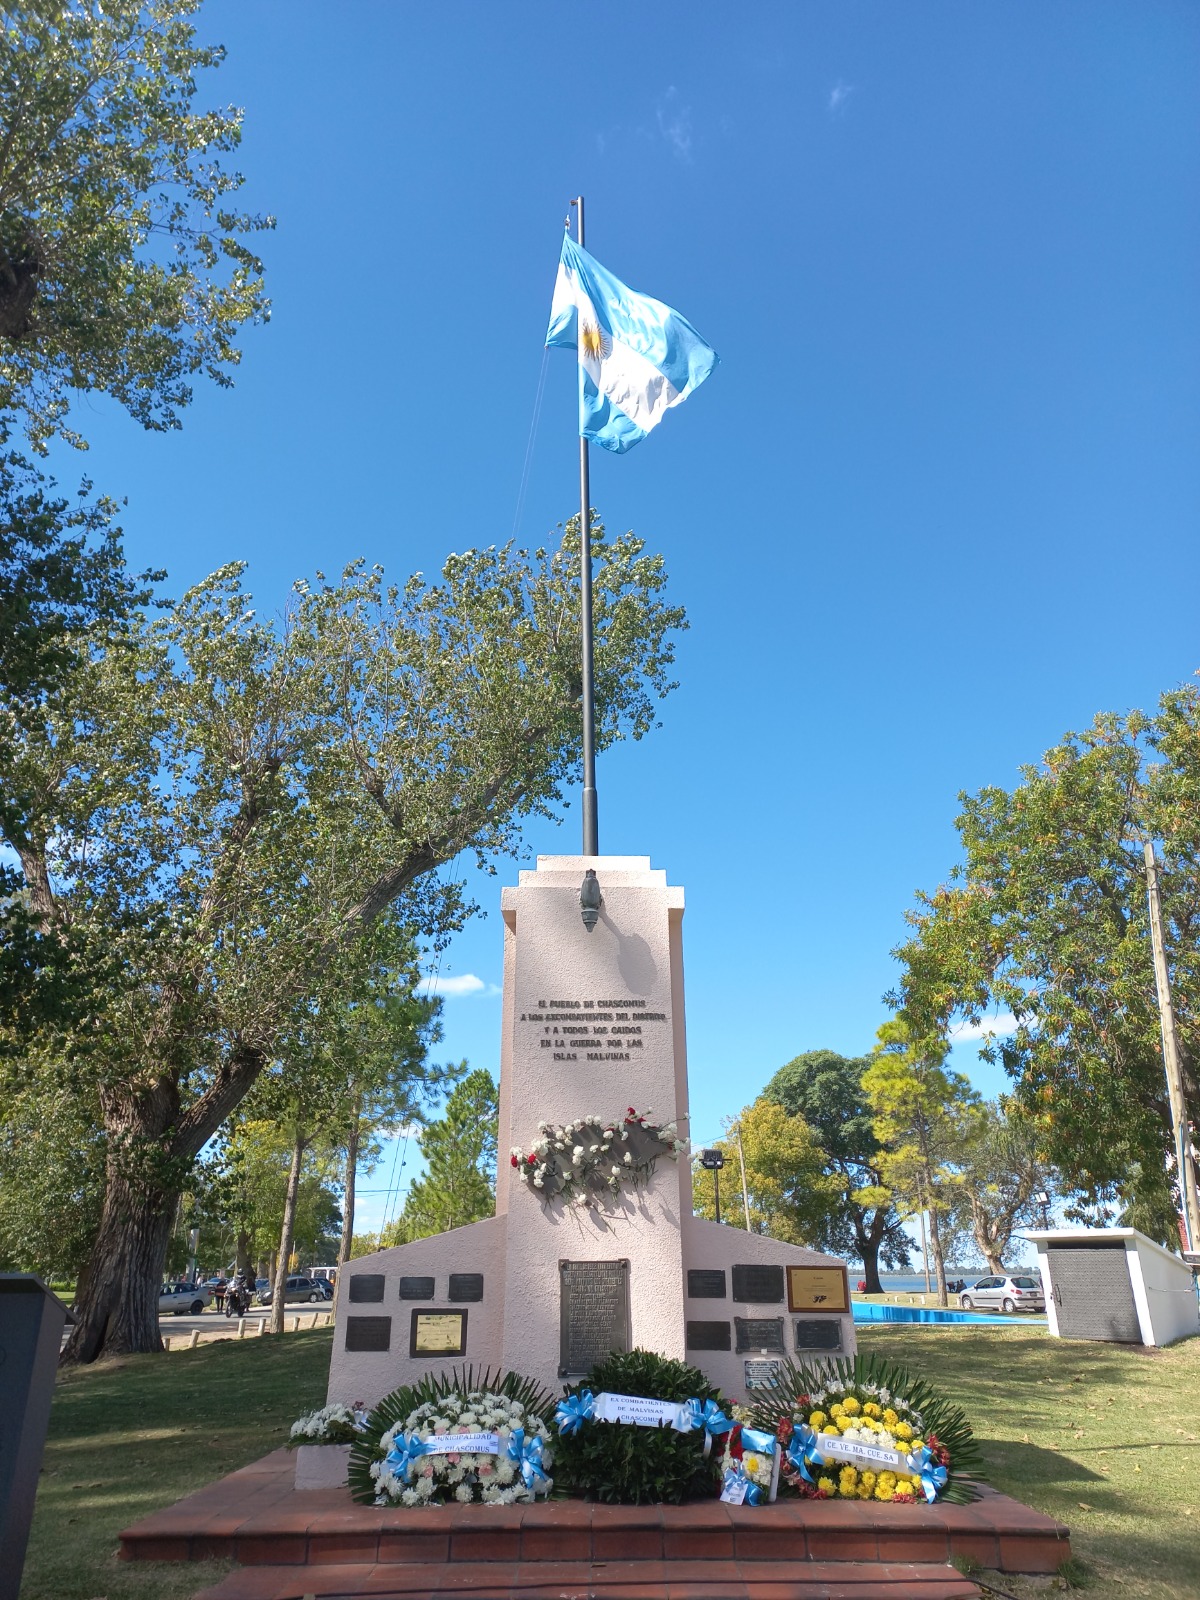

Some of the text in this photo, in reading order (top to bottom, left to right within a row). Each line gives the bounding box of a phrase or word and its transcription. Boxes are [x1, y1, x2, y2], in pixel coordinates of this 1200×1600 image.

[538, 1000, 646, 1009] EL PUEBLO DE CHASCOMUS
[520, 1013, 526, 1021] A
[528, 1013, 543, 1021] LOS
[616, 1013, 630, 1021] DEL
[632, 1013, 666, 1021] DISTRITO
[552, 1026, 559, 1034] A
[562, 1026, 589, 1034] TODOS
[593, 1026, 608, 1034] LOS
[611, 1026, 642, 1034] CAIDOS
[540, 1039, 643, 1048] EN LA GUERRA POR LAS
[553, 1052, 630, 1061] ISLAS MALVINAS
[621, 1398, 671, 1406] COMBATIENTES
[434, 1433, 492, 1441] MUNICIPALIDAD
[444, 1445, 490, 1453] CHASCOMUS
[827, 1441, 837, 1449] CE.
[839, 1443, 851, 1452] VE.
[852, 1446, 866, 1455] MA.
